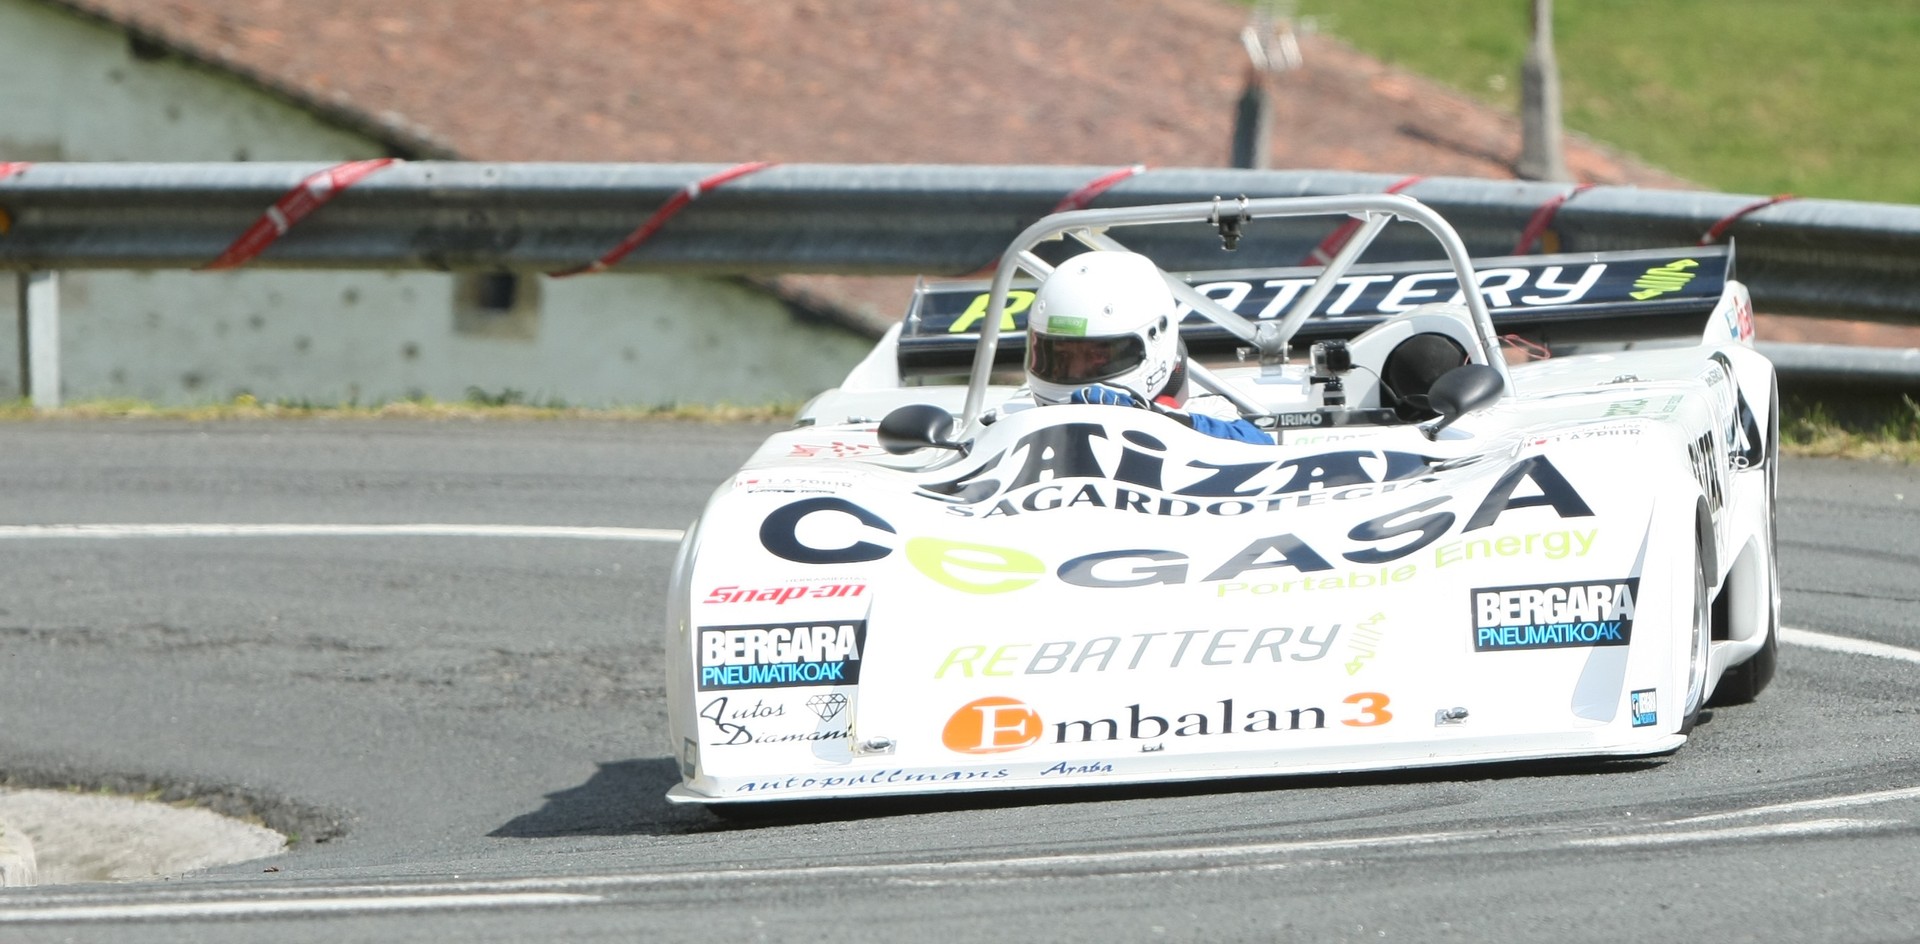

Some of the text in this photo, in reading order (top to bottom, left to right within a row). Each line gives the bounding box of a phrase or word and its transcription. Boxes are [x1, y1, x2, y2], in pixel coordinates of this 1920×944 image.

[1281, 412, 1322, 426] IRIMO
[1217, 529, 1598, 598] Portable Energy
[703, 585, 867, 605] Snap-on
[1476, 584, 1634, 626] BERGARA
[702, 625, 860, 667] BERGARA
[1477, 621, 1622, 647] PNEUMATIKOAK
[934, 623, 1342, 679] REBATTERY
[702, 661, 844, 687] PNEUMATIKOAK
[700, 697, 786, 726] Autos
[966, 692, 1394, 752] Embalan 3
[735, 761, 1114, 793] autopullmans Araba
